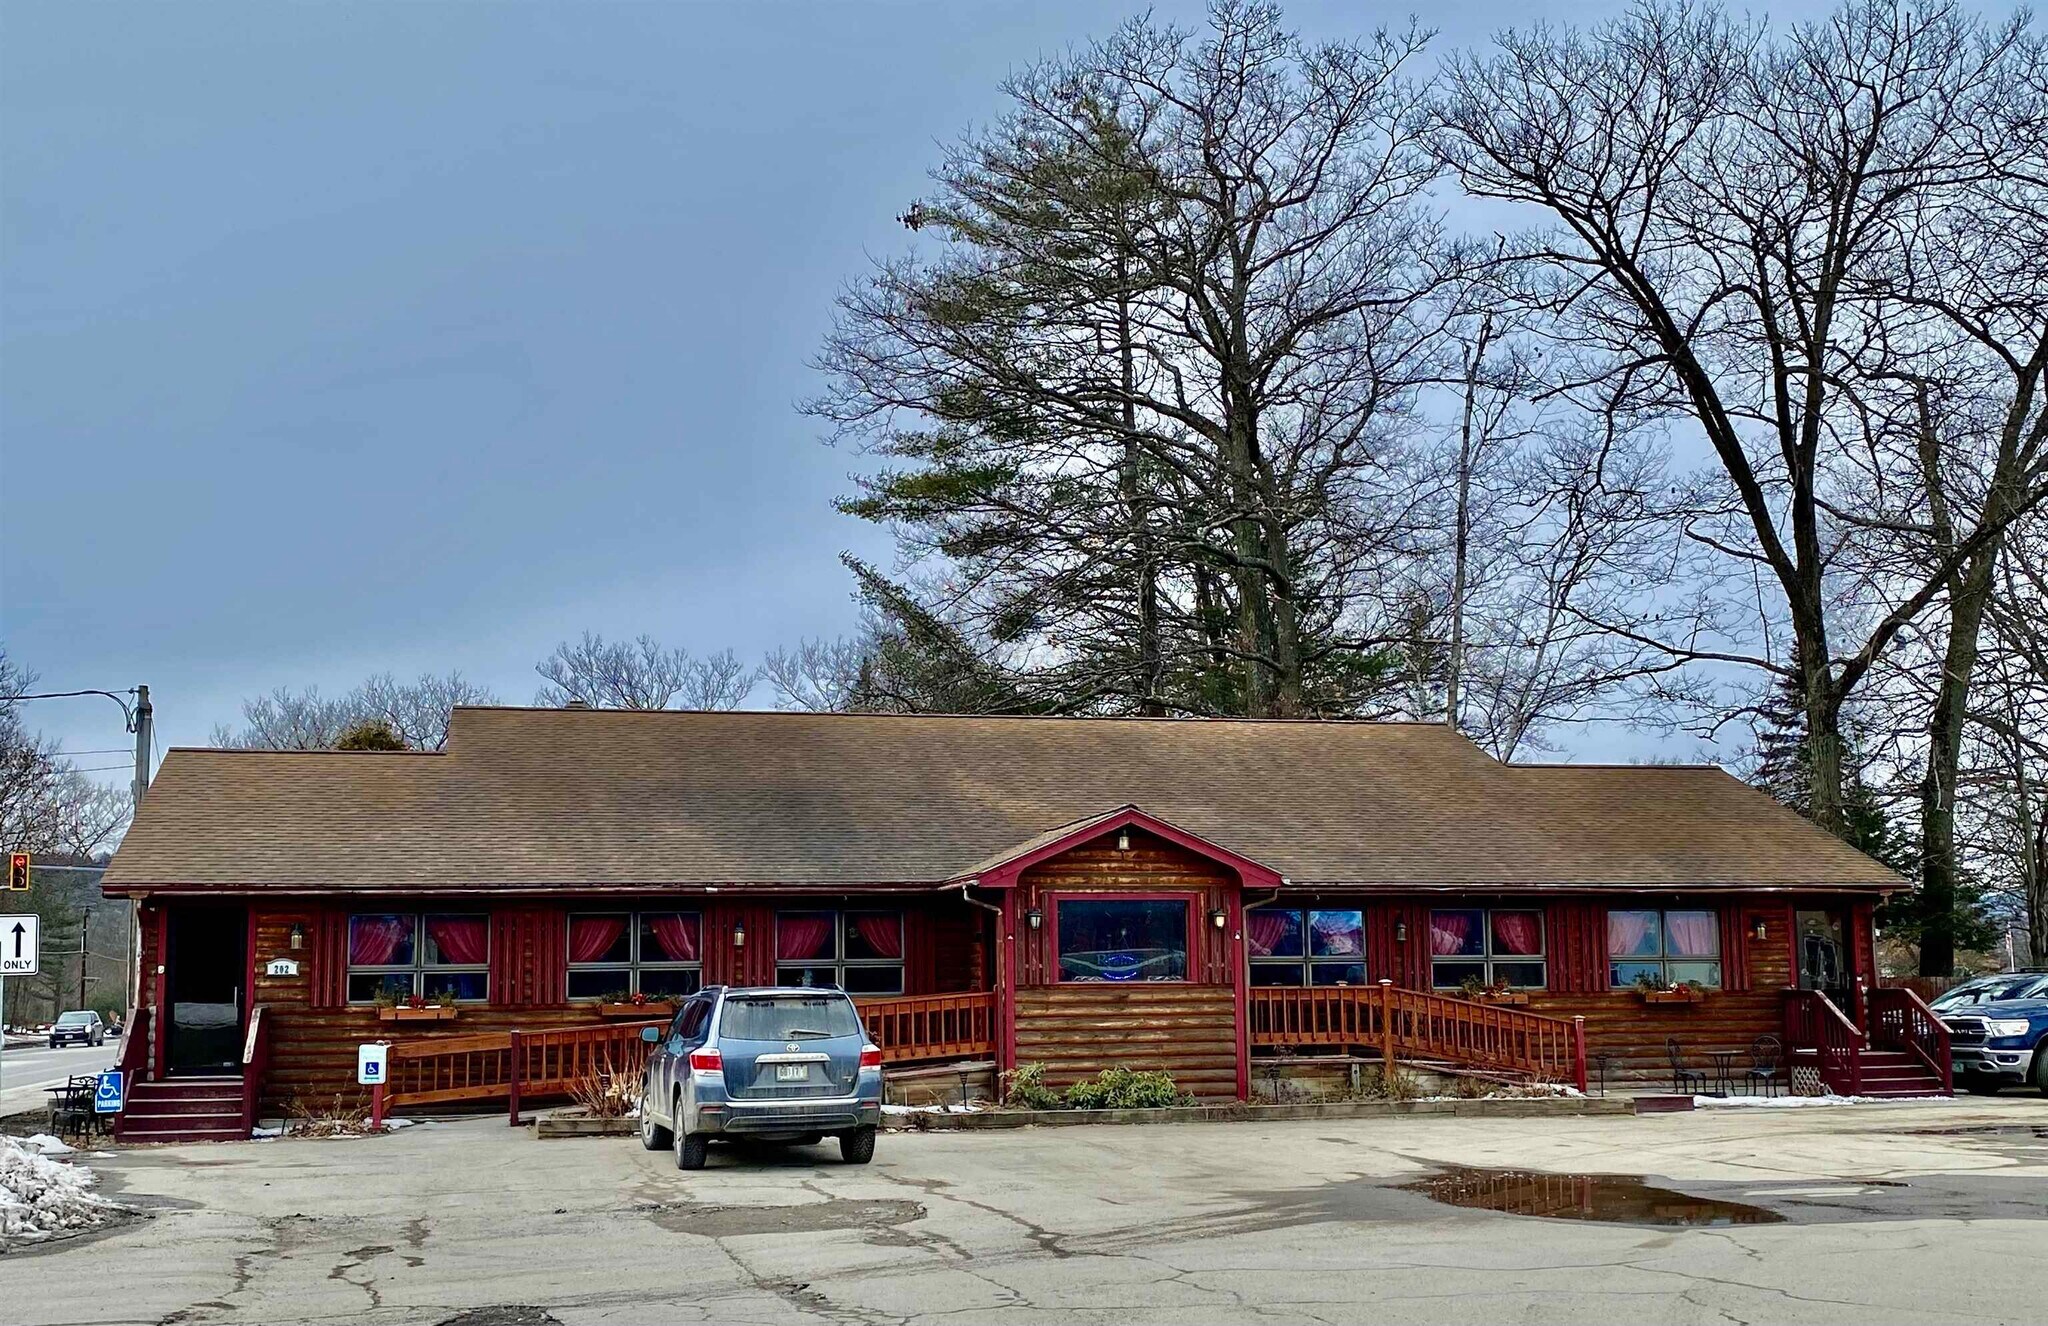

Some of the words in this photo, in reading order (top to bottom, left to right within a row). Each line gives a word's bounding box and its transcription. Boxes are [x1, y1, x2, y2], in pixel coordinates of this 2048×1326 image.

[4, 960, 31, 969] ONLY
[274, 964, 289, 974] 202
[97, 1099, 121, 1108] PARKING
